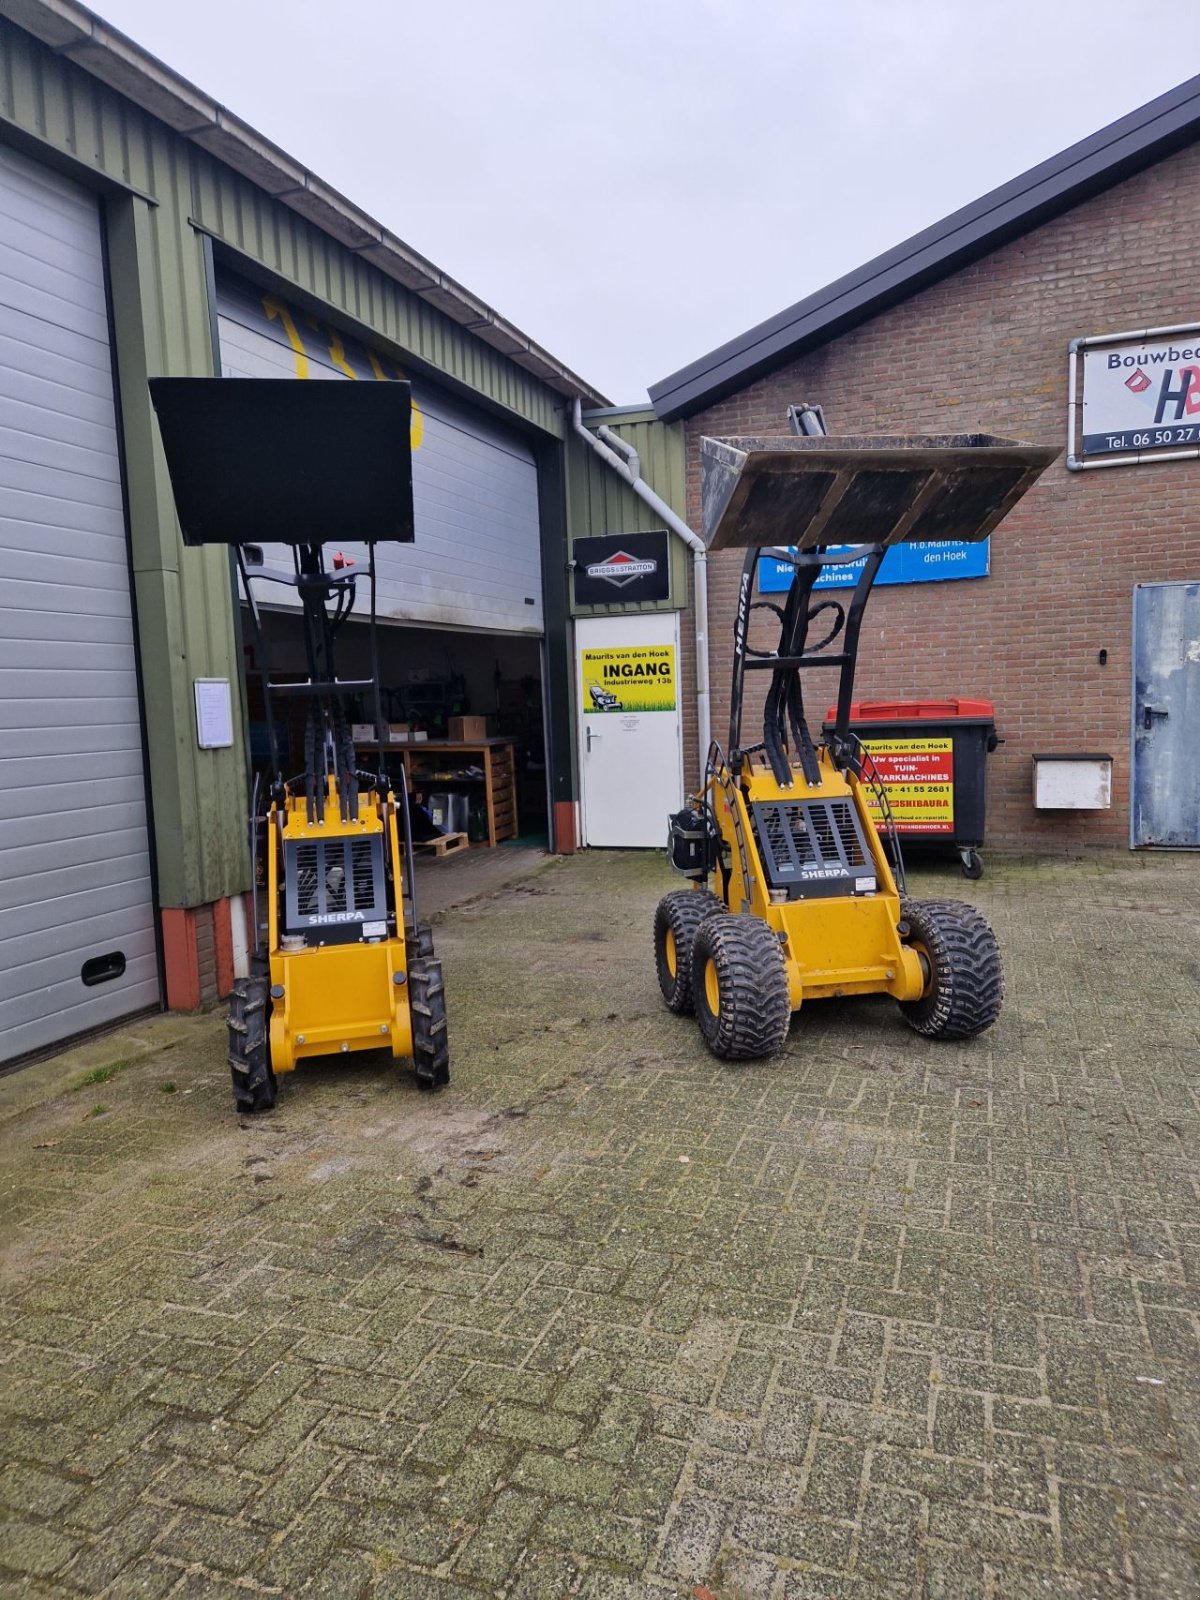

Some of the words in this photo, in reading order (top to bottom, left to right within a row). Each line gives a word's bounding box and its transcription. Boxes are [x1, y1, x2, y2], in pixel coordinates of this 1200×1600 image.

[1106, 436, 1128, 448] Tel.
[1133, 433, 1150, 446] 06
[1154, 431, 1172, 444] 50
[1176, 428, 1194, 441] 27
[924, 552, 941, 562] den
[943, 550, 968, 561] Hoek
[816, 572, 854, 582] chines
[585, 652, 614, 660] Maurits
[603, 662, 670, 677] INGANG
[604, 678, 653, 686] Industrieweg
[872, 755, 886, 763] Uw
[801, 869, 850, 879] SHERPA
[309, 912, 365, 924] SHERPA
